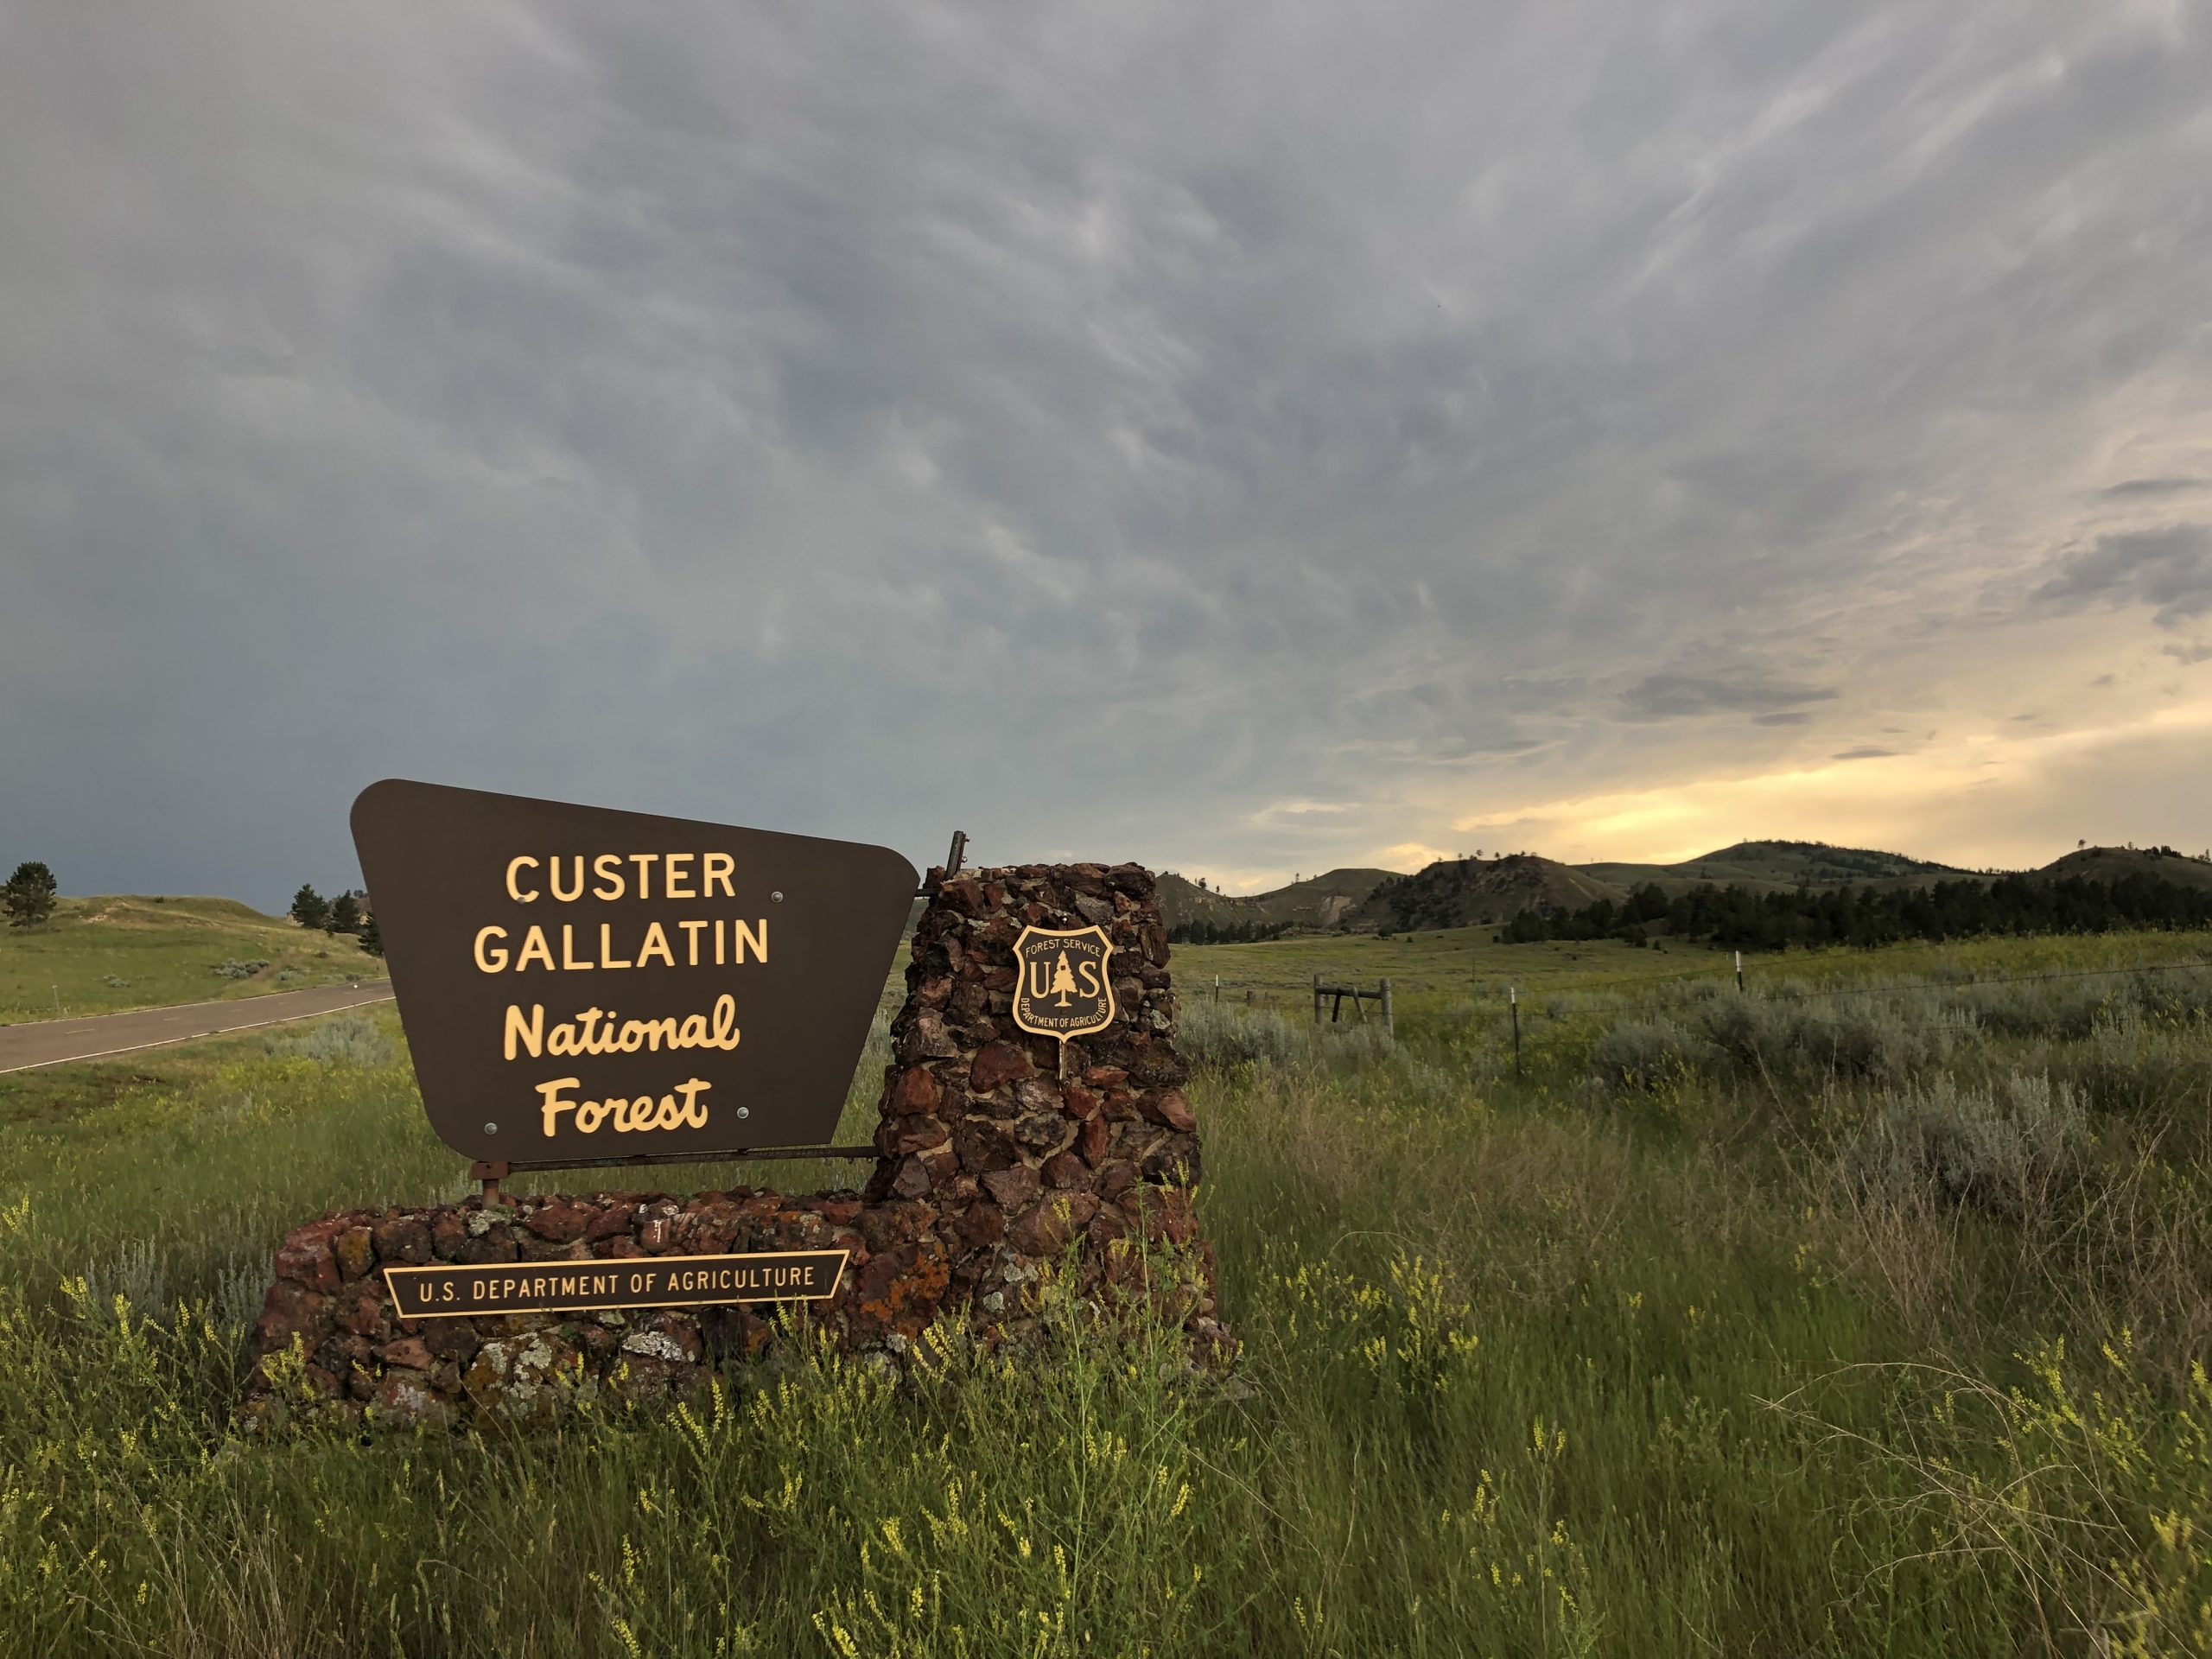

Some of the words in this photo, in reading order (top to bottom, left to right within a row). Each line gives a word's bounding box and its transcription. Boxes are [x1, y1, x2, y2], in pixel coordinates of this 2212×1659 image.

[505, 852, 736, 902] CUSTER
[474, 918, 768, 973] GALLATIN
[1026, 939, 1060, 957] FOREST
[1063, 939, 1101, 957] SERVICE
[504, 993, 741, 1060] National
[1020, 997, 1058, 1027] DEPARTMENT
[1059, 1018, 1070, 1028] OF
[1070, 997, 1107, 1027] AGRICULTURE
[535, 1077, 712, 1137] Forest
[419, 1281, 461, 1303] U.S.
[473, 1274, 618, 1300] DEPARTMENT
[630, 1273, 657, 1294] OF
[667, 1266, 815, 1291] AGRICULTURE
